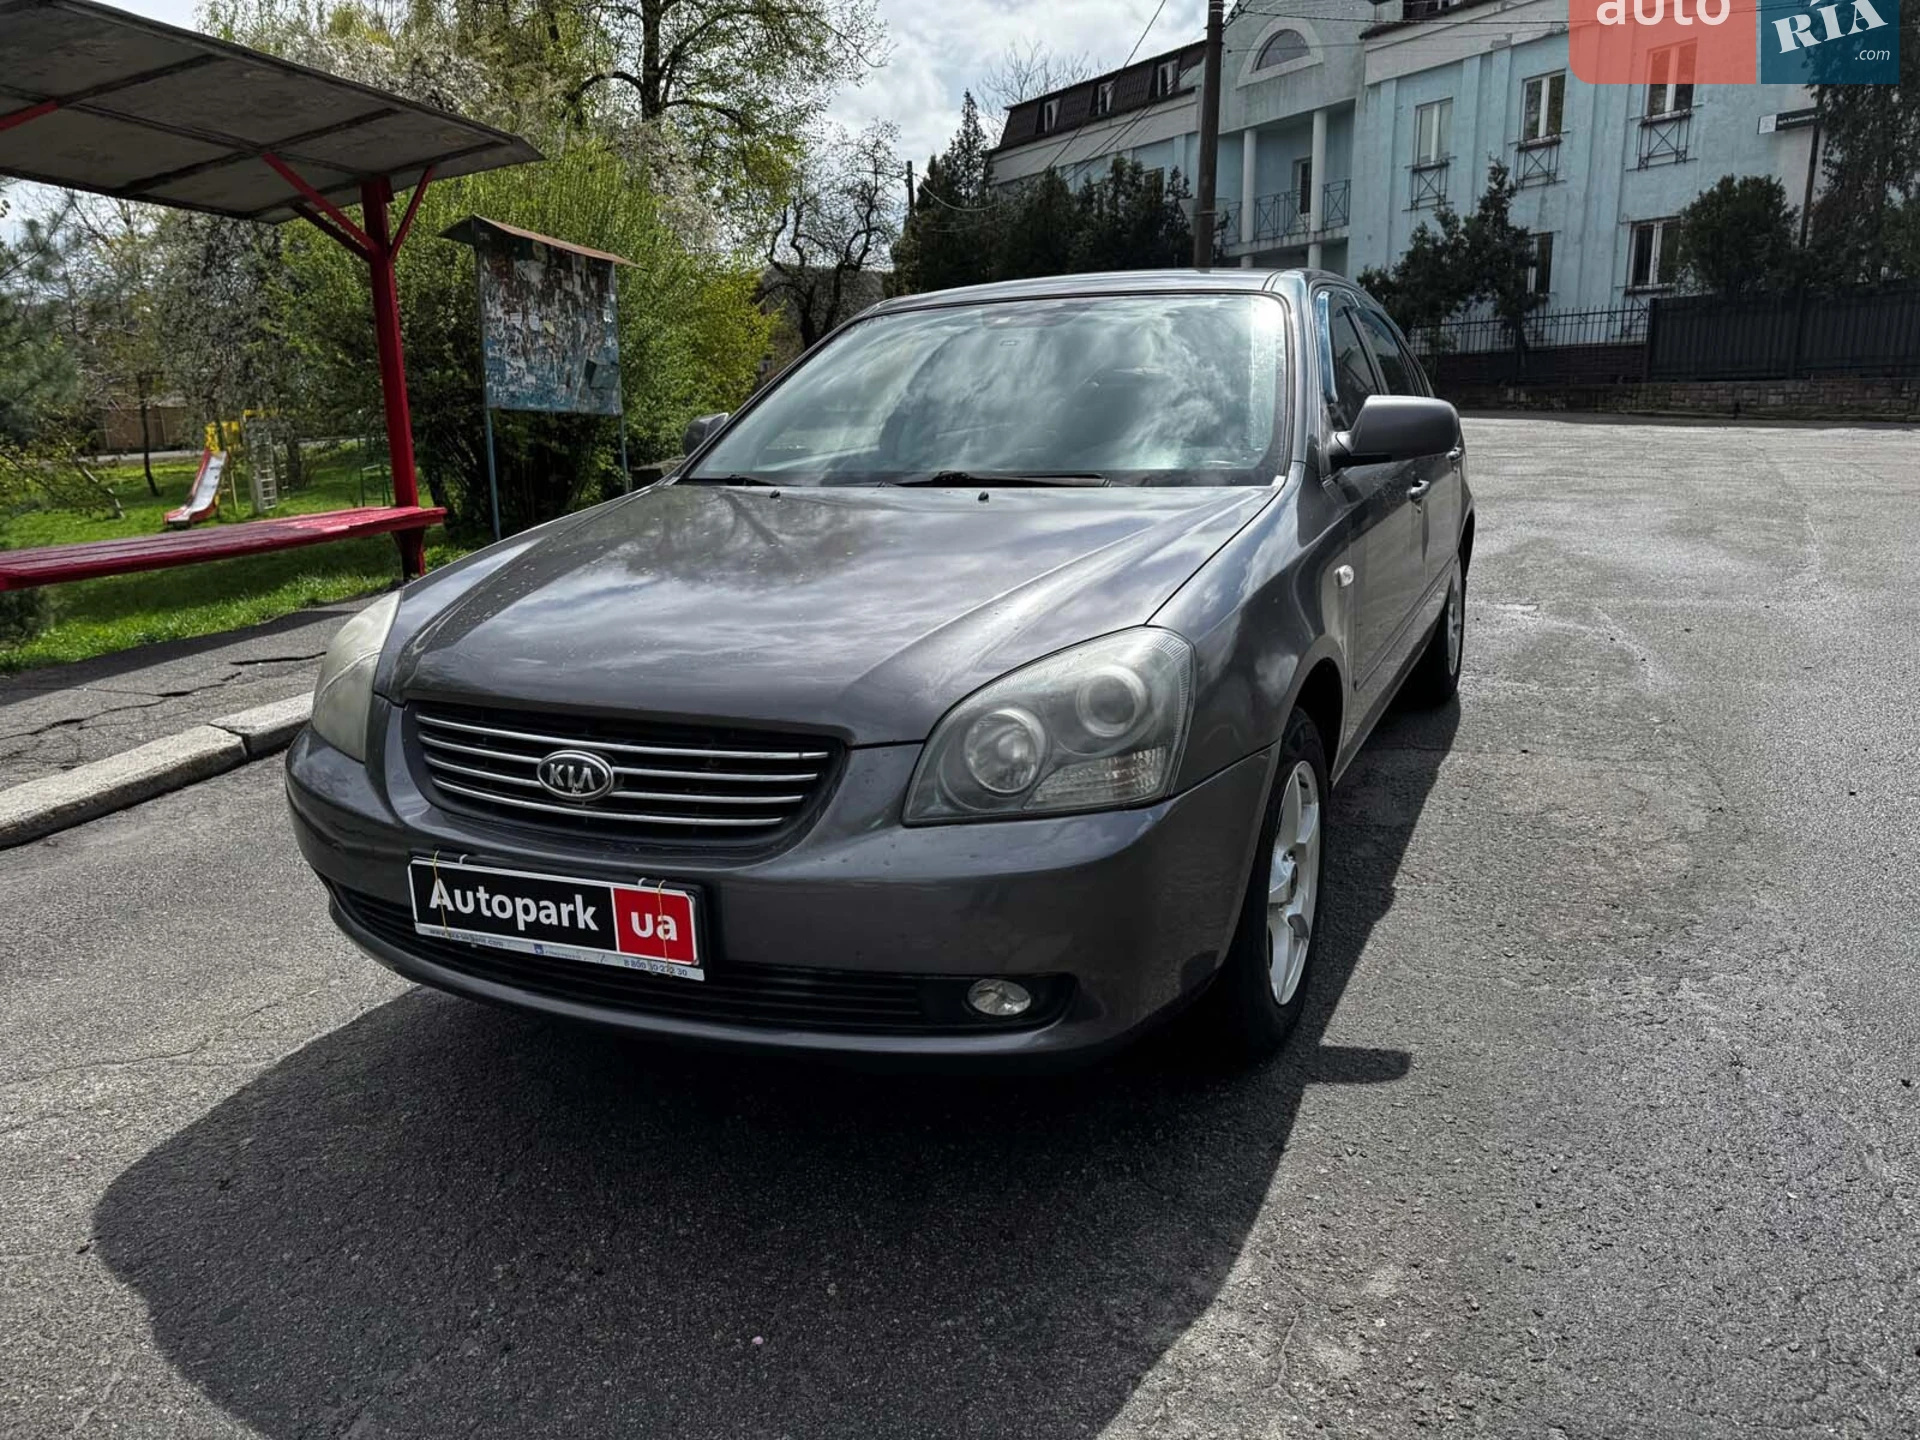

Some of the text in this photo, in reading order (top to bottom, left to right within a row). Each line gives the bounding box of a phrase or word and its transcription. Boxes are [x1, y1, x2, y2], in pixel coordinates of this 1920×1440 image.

[548, 762, 597, 790] KIA
[429, 877, 679, 942] Autopark ua
